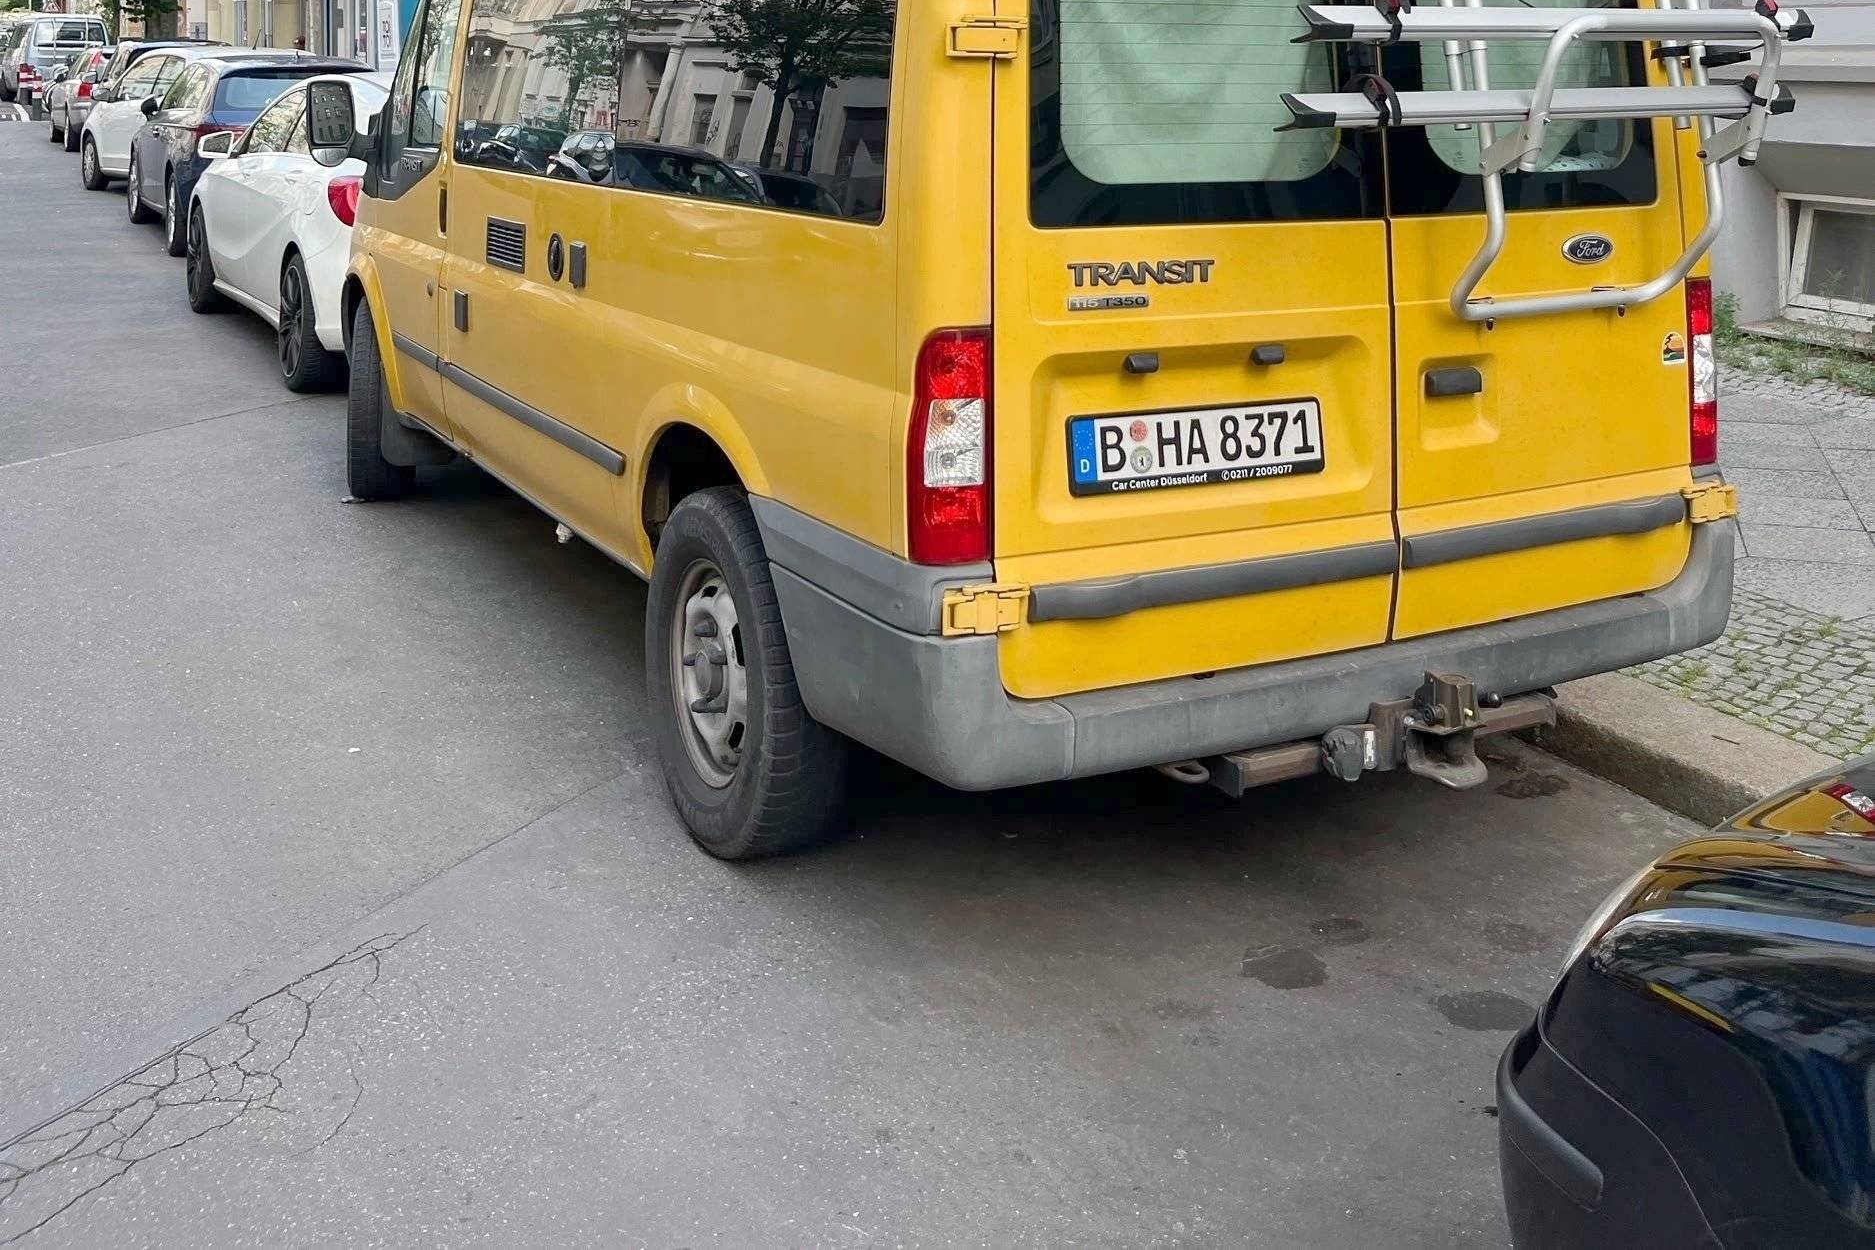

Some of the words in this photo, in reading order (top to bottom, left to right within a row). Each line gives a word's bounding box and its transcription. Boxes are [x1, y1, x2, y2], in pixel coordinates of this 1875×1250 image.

[1577, 240, 1605, 257] Ford
[1067, 260, 1214, 287] TRANSIT
[1103, 296, 1147, 307] T350
[1100, 425, 1126, 473] B
[1156, 418, 1210, 468] HA
[1220, 409, 1315, 462] 8371
[1080, 459, 1090, 473] D
[1112, 480, 1128, 491] Car
[1129, 476, 1159, 489] Center
[1160, 472, 1208, 486] Düsseldorf
[1256, 464, 1293, 477] 2009077
